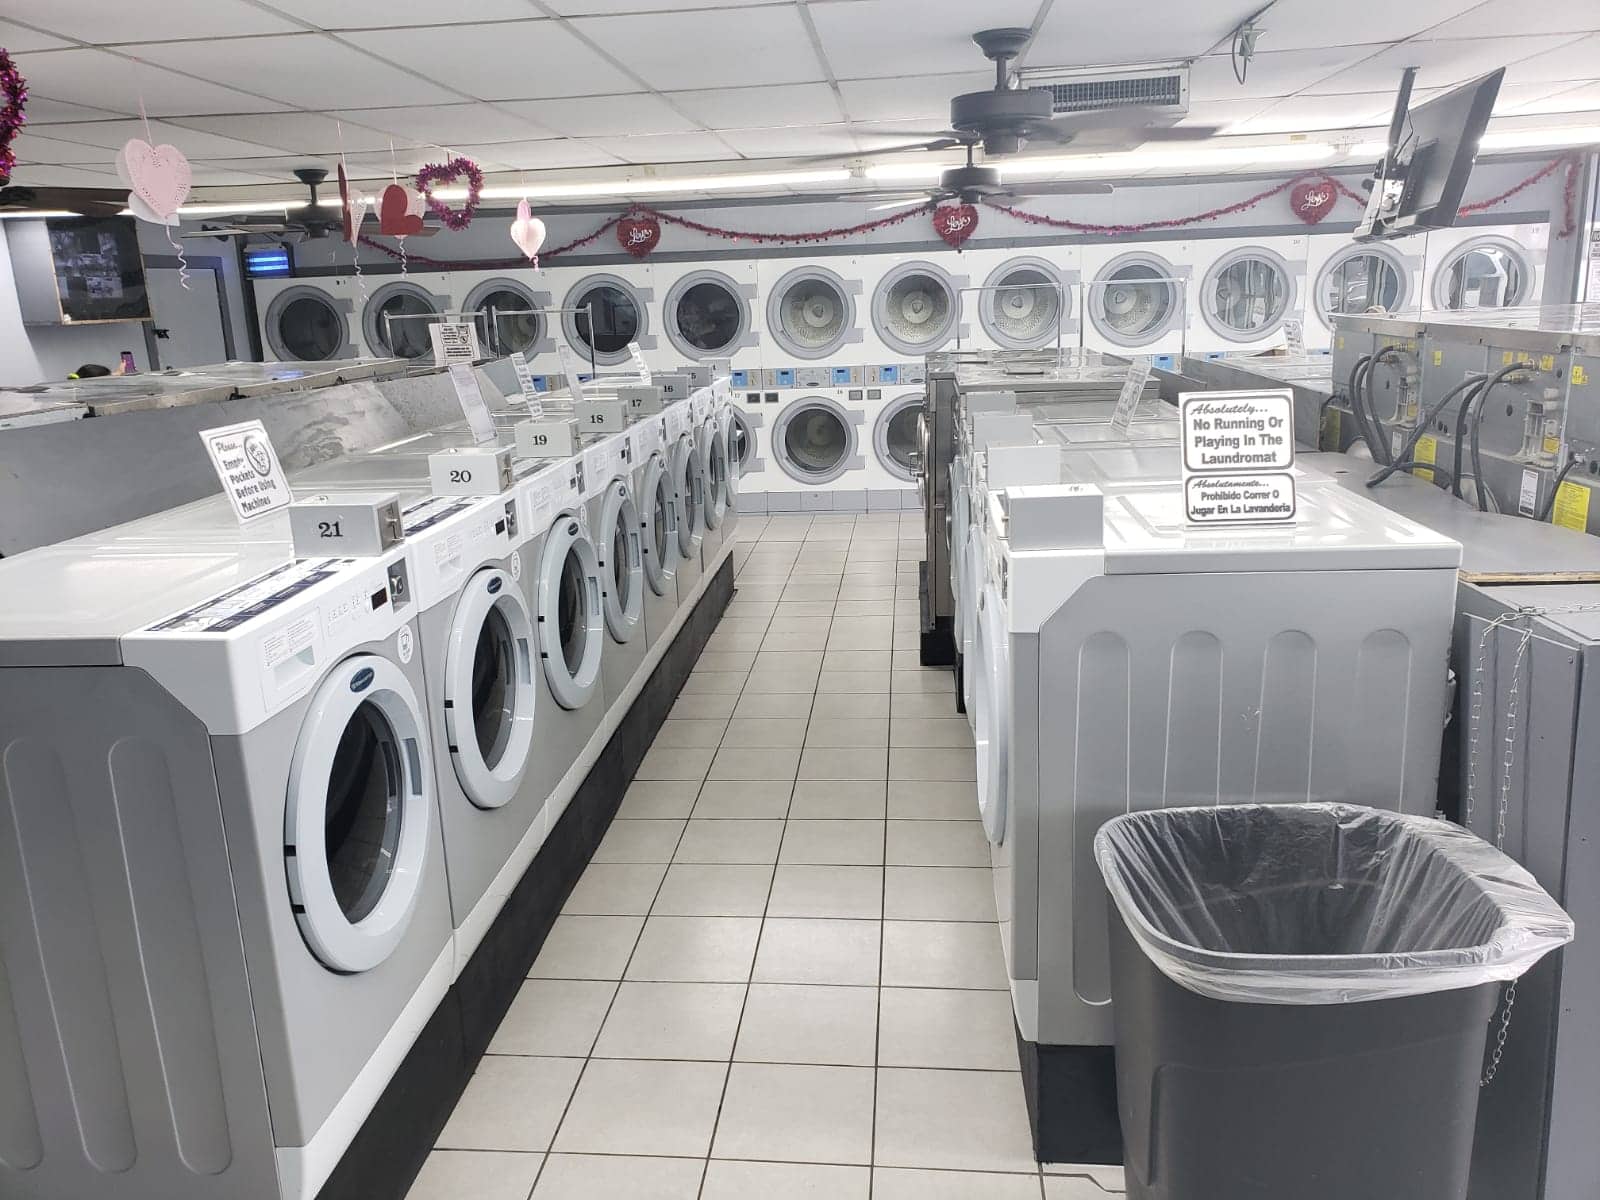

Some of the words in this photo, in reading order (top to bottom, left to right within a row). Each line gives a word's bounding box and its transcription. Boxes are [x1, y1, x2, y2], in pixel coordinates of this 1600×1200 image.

[663, 385, 674, 393] 16
[631, 399, 643, 408] 17
[1190, 402, 1269, 415] Absolutely...
[590, 414, 604, 424] 18
[1193, 418, 1211, 431] No
[1214, 417, 1265, 432] Running
[1268, 416, 1284, 429] Or
[532, 434, 548, 446] 19
[1194, 435, 1240, 450] Playing
[1243, 434, 1256, 447] In
[1259, 432, 1284, 446] The
[1201, 451, 1277, 465] Laundromat
[229, 470, 256, 485] Pockets
[449, 470, 472, 483] 20
[235, 484, 259, 499] Before
[257, 479, 277, 492] Using
[1201, 490, 1242, 501] Prohibido
[1243, 489, 1271, 500] Correr
[1272, 489, 1280, 499] O
[241, 496, 271, 512] Machines
[1190, 505, 1216, 517] Jugar
[1217, 504, 1229, 514] En
[1230, 504, 1241, 514] La
[318, 521, 343, 538] 21
